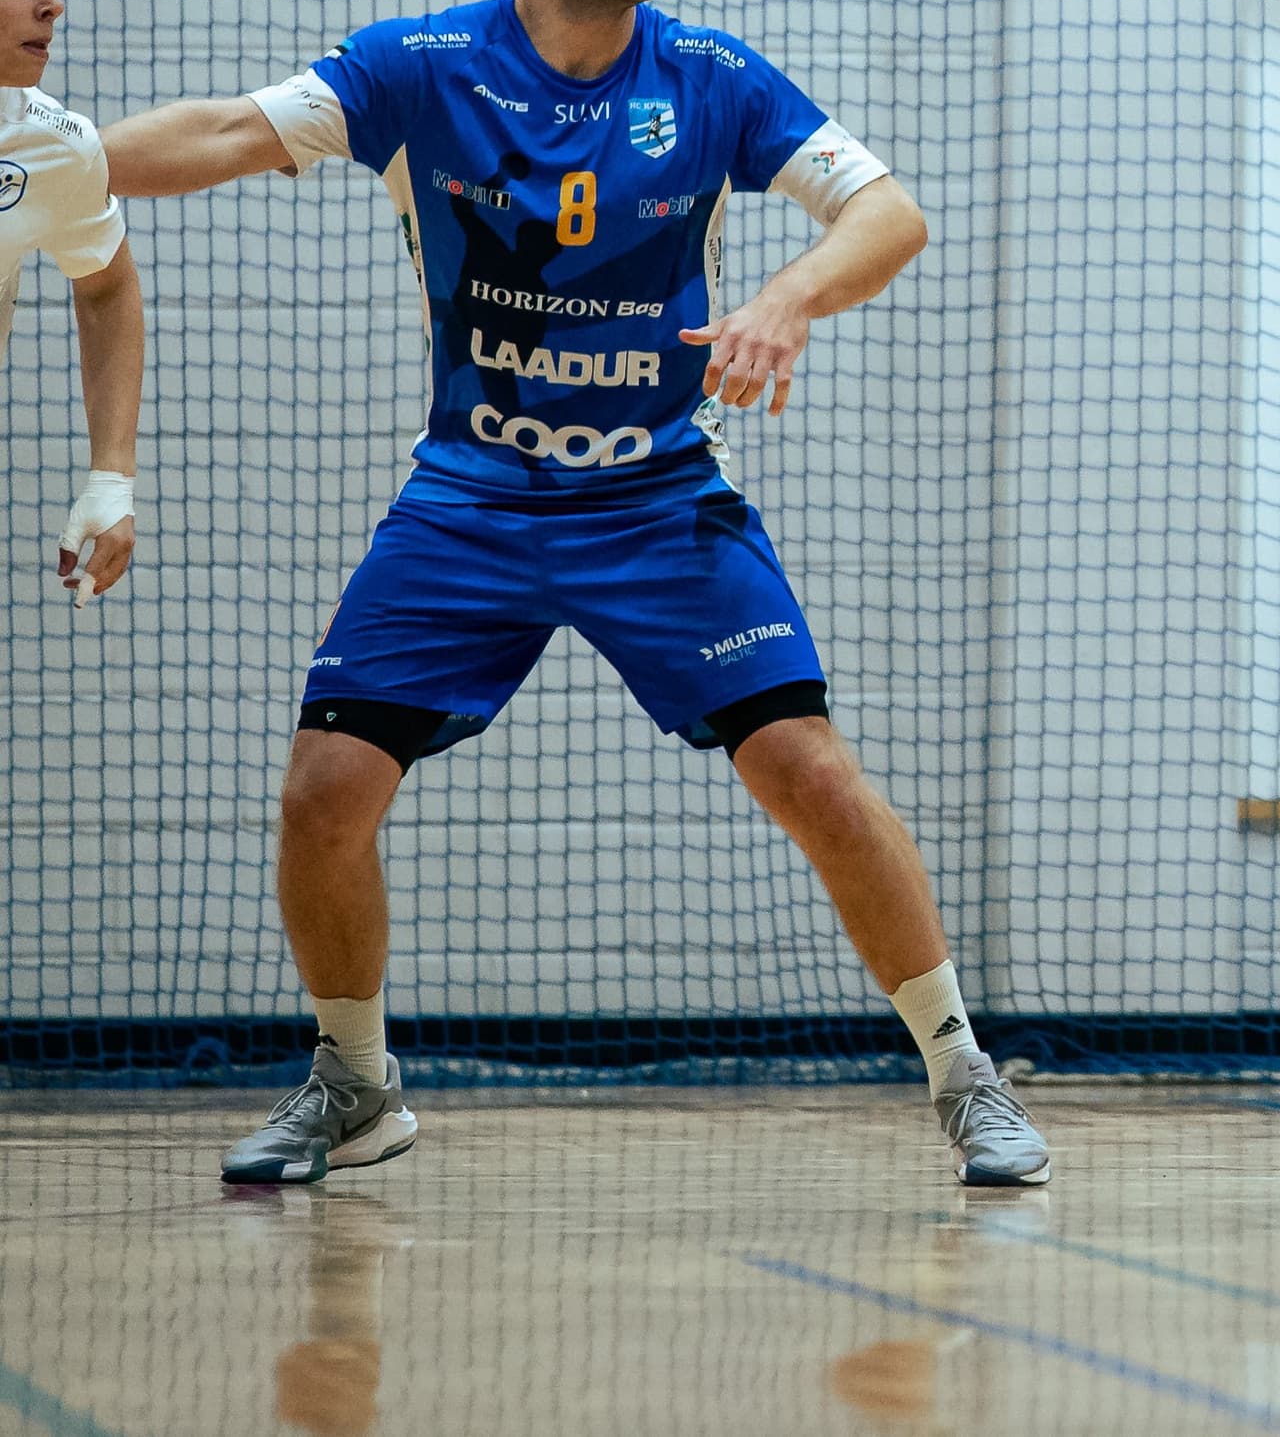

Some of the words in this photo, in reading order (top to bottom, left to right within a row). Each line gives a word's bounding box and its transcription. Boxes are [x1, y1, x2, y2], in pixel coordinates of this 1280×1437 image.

[439, 32, 473, 43] VALD
[674, 38, 715, 49] ANIJA
[715, 44, 746, 68] VALD
[554, 101, 611, 124] SU.VI
[433, 168, 486, 203] Mobil
[556, 170, 597, 247] 8
[638, 194, 690, 219] Mobil
[471, 279, 610, 316] HORIZON
[615, 301, 664, 318] Bag
[470, 327, 660, 387] LAADUR
[714, 622, 795, 656] MULTIMEK
[719, 645, 756, 666] BALTIC
